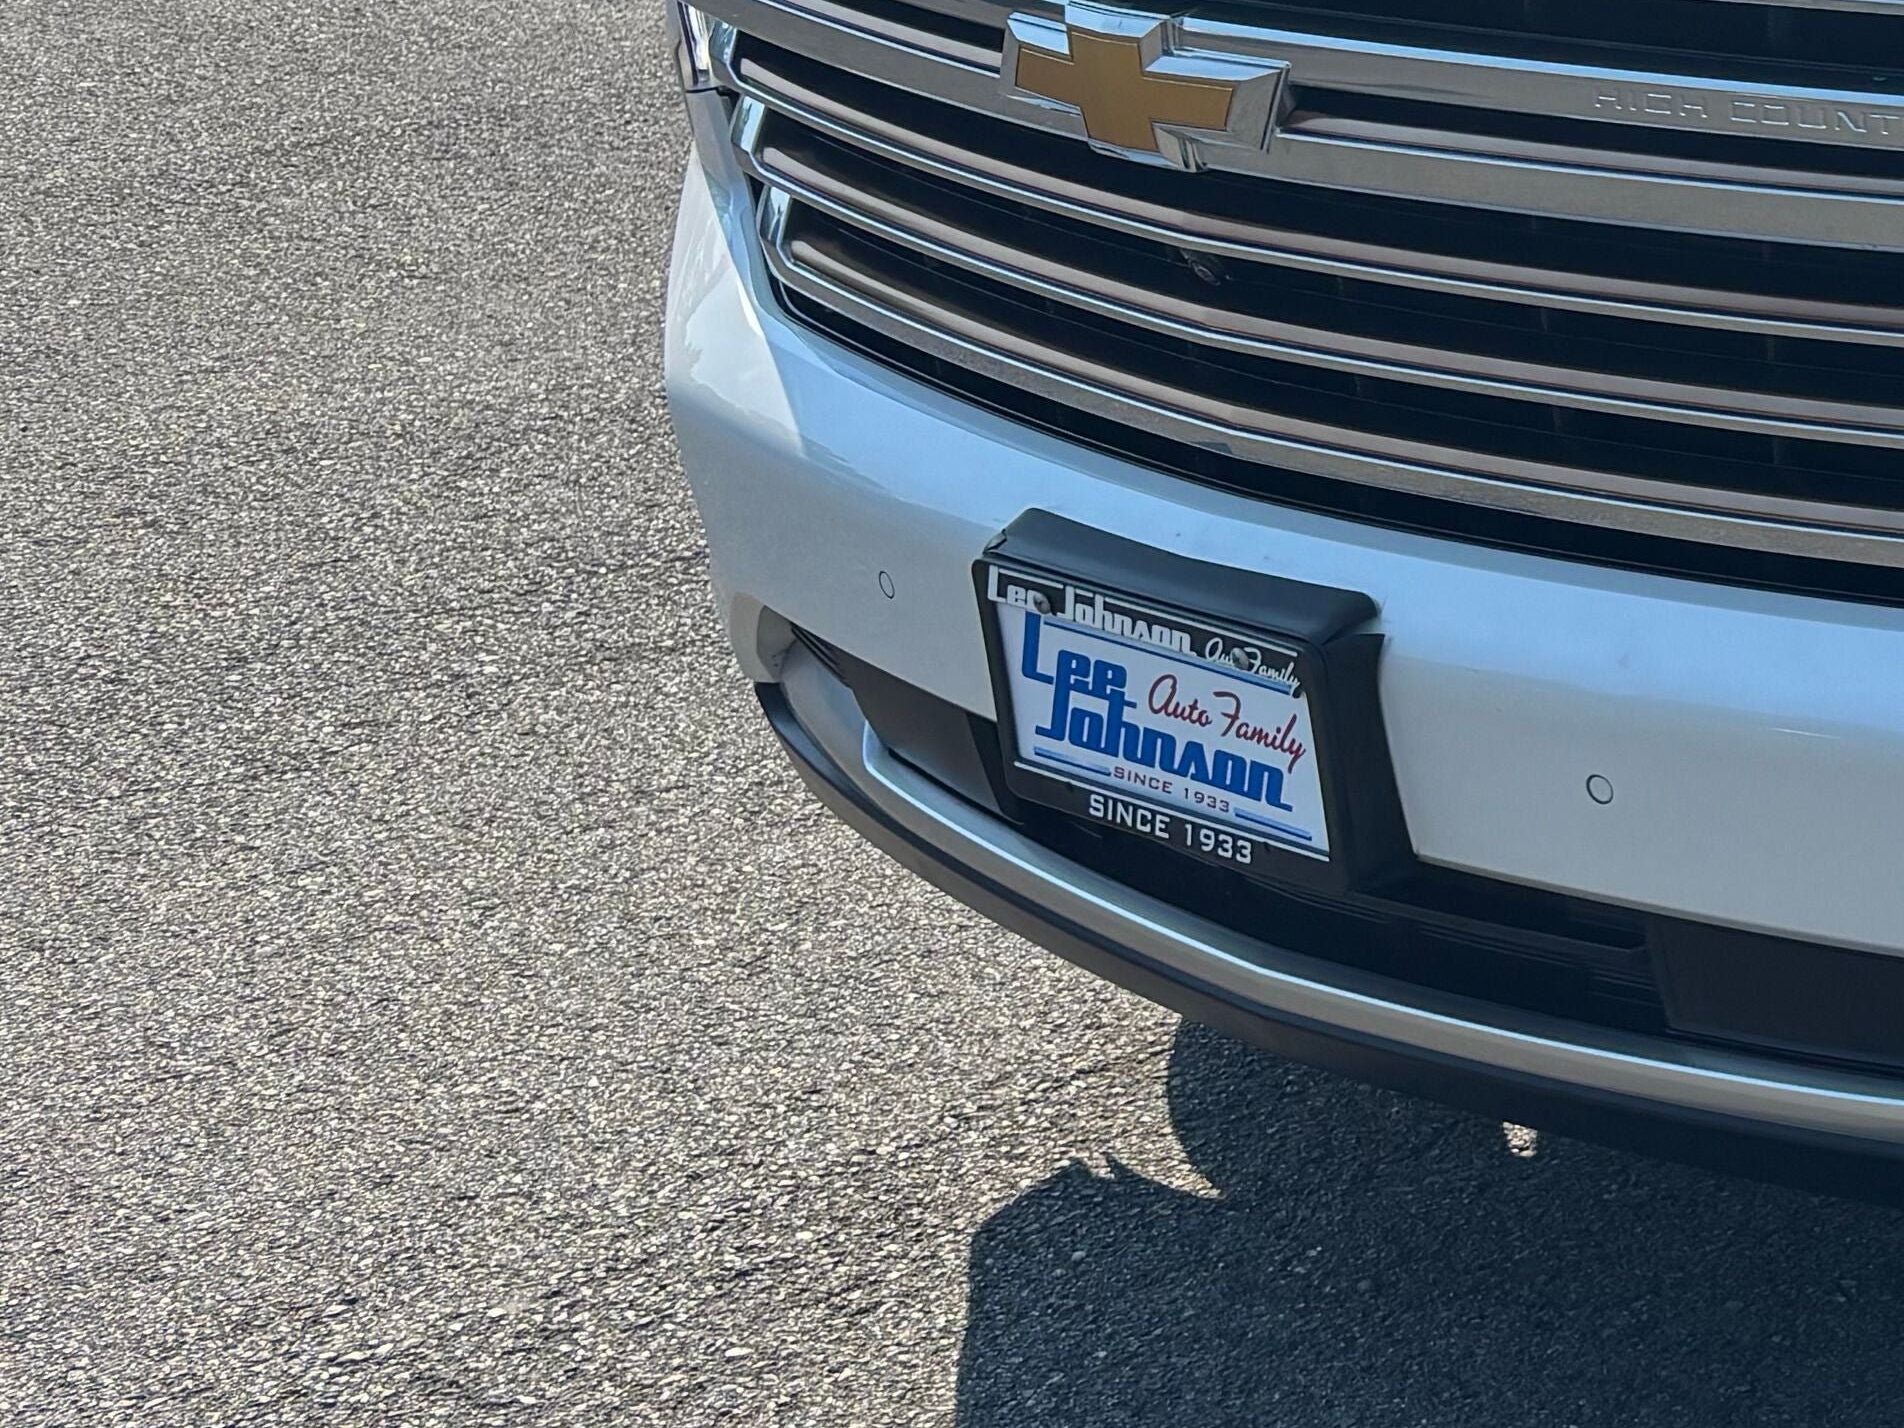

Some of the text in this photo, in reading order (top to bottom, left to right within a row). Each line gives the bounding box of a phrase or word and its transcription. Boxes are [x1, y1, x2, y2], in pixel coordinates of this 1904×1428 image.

[1595, 92, 1707, 119] HIGH
[1056, 585, 1198, 657] Johnson
[1205, 637, 1248, 670] Au
[1243, 647, 1300, 697] Family
[1022, 613, 1306, 774] Lee Auto Family
[1035, 684, 1293, 812] Johnson
[1114, 766, 1230, 813] SINCE 1933
[1089, 794, 1252, 864] SINCE 1933
